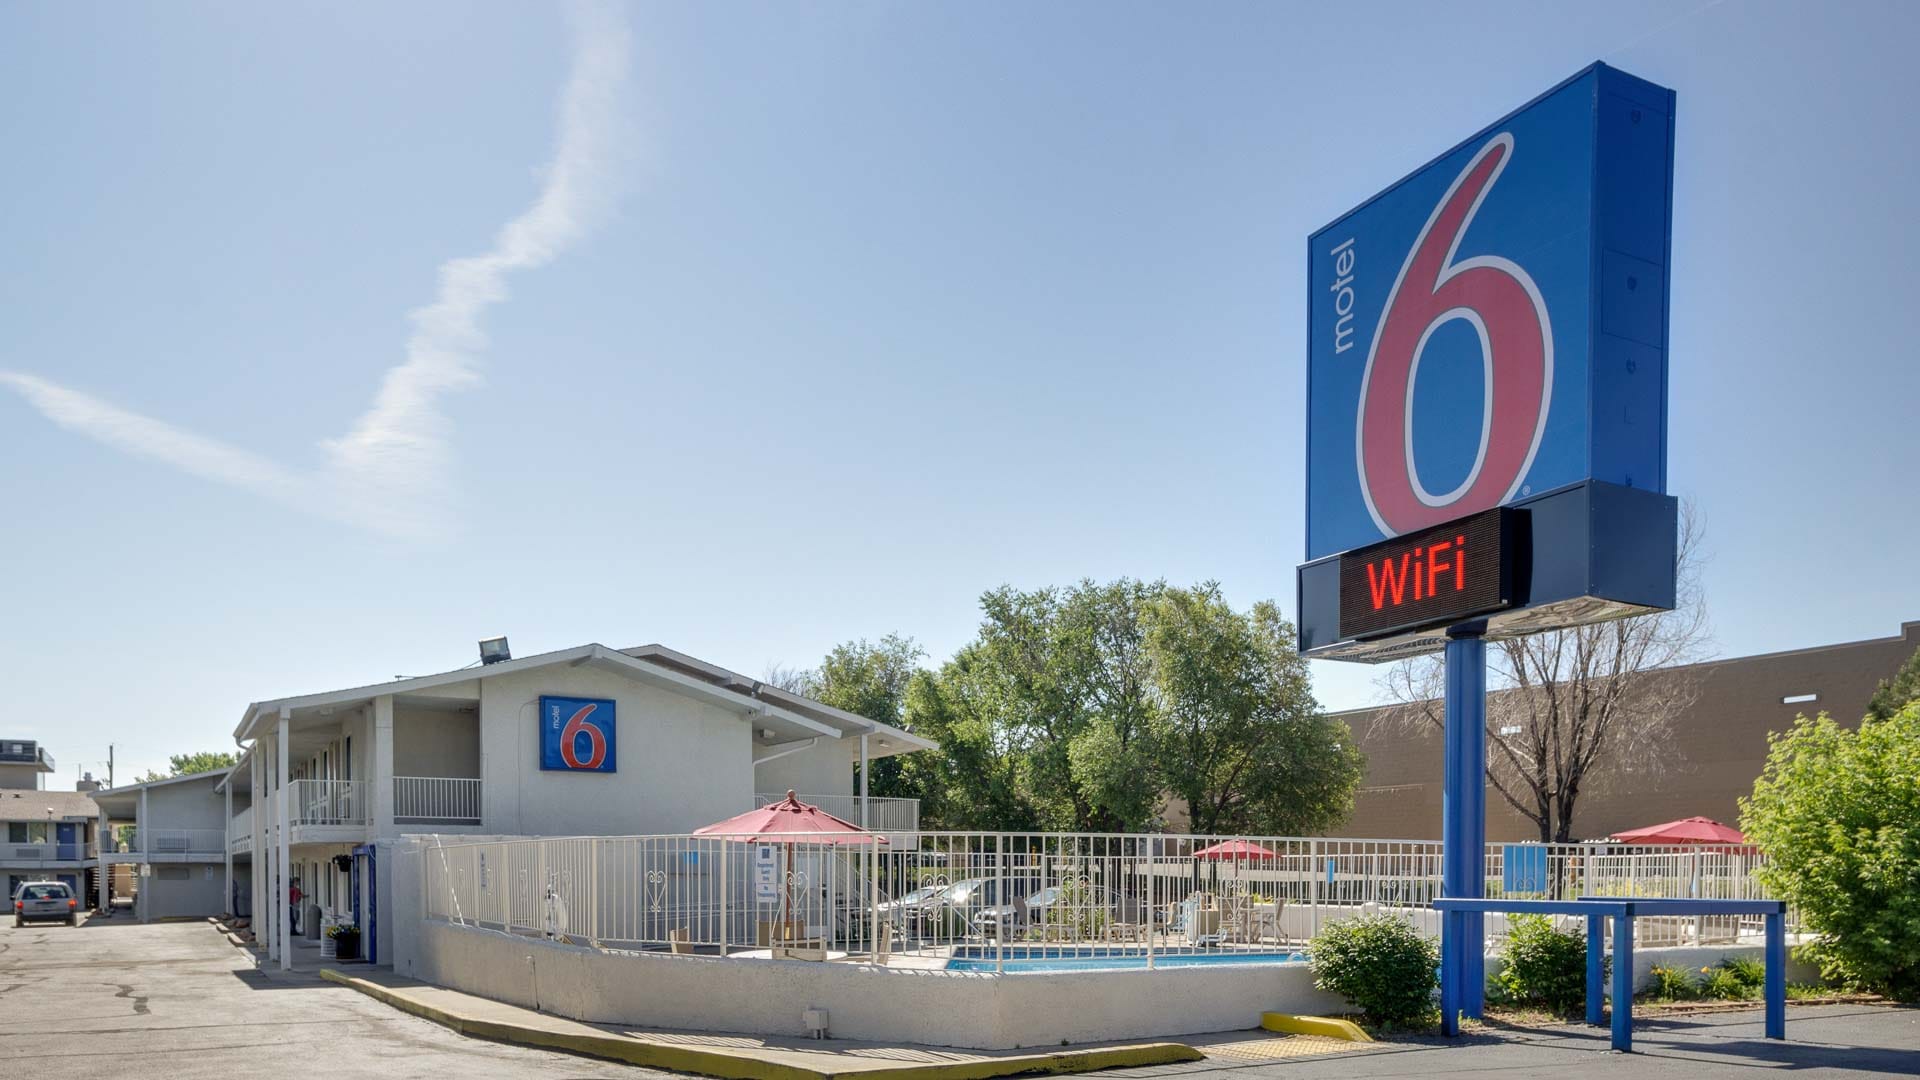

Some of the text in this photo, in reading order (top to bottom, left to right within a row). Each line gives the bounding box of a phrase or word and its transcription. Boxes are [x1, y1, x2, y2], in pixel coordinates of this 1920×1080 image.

[1331, 132, 1554, 539] motel 6
[1366, 535, 1465, 612] WiFi
[560, 703, 607, 769] 6
